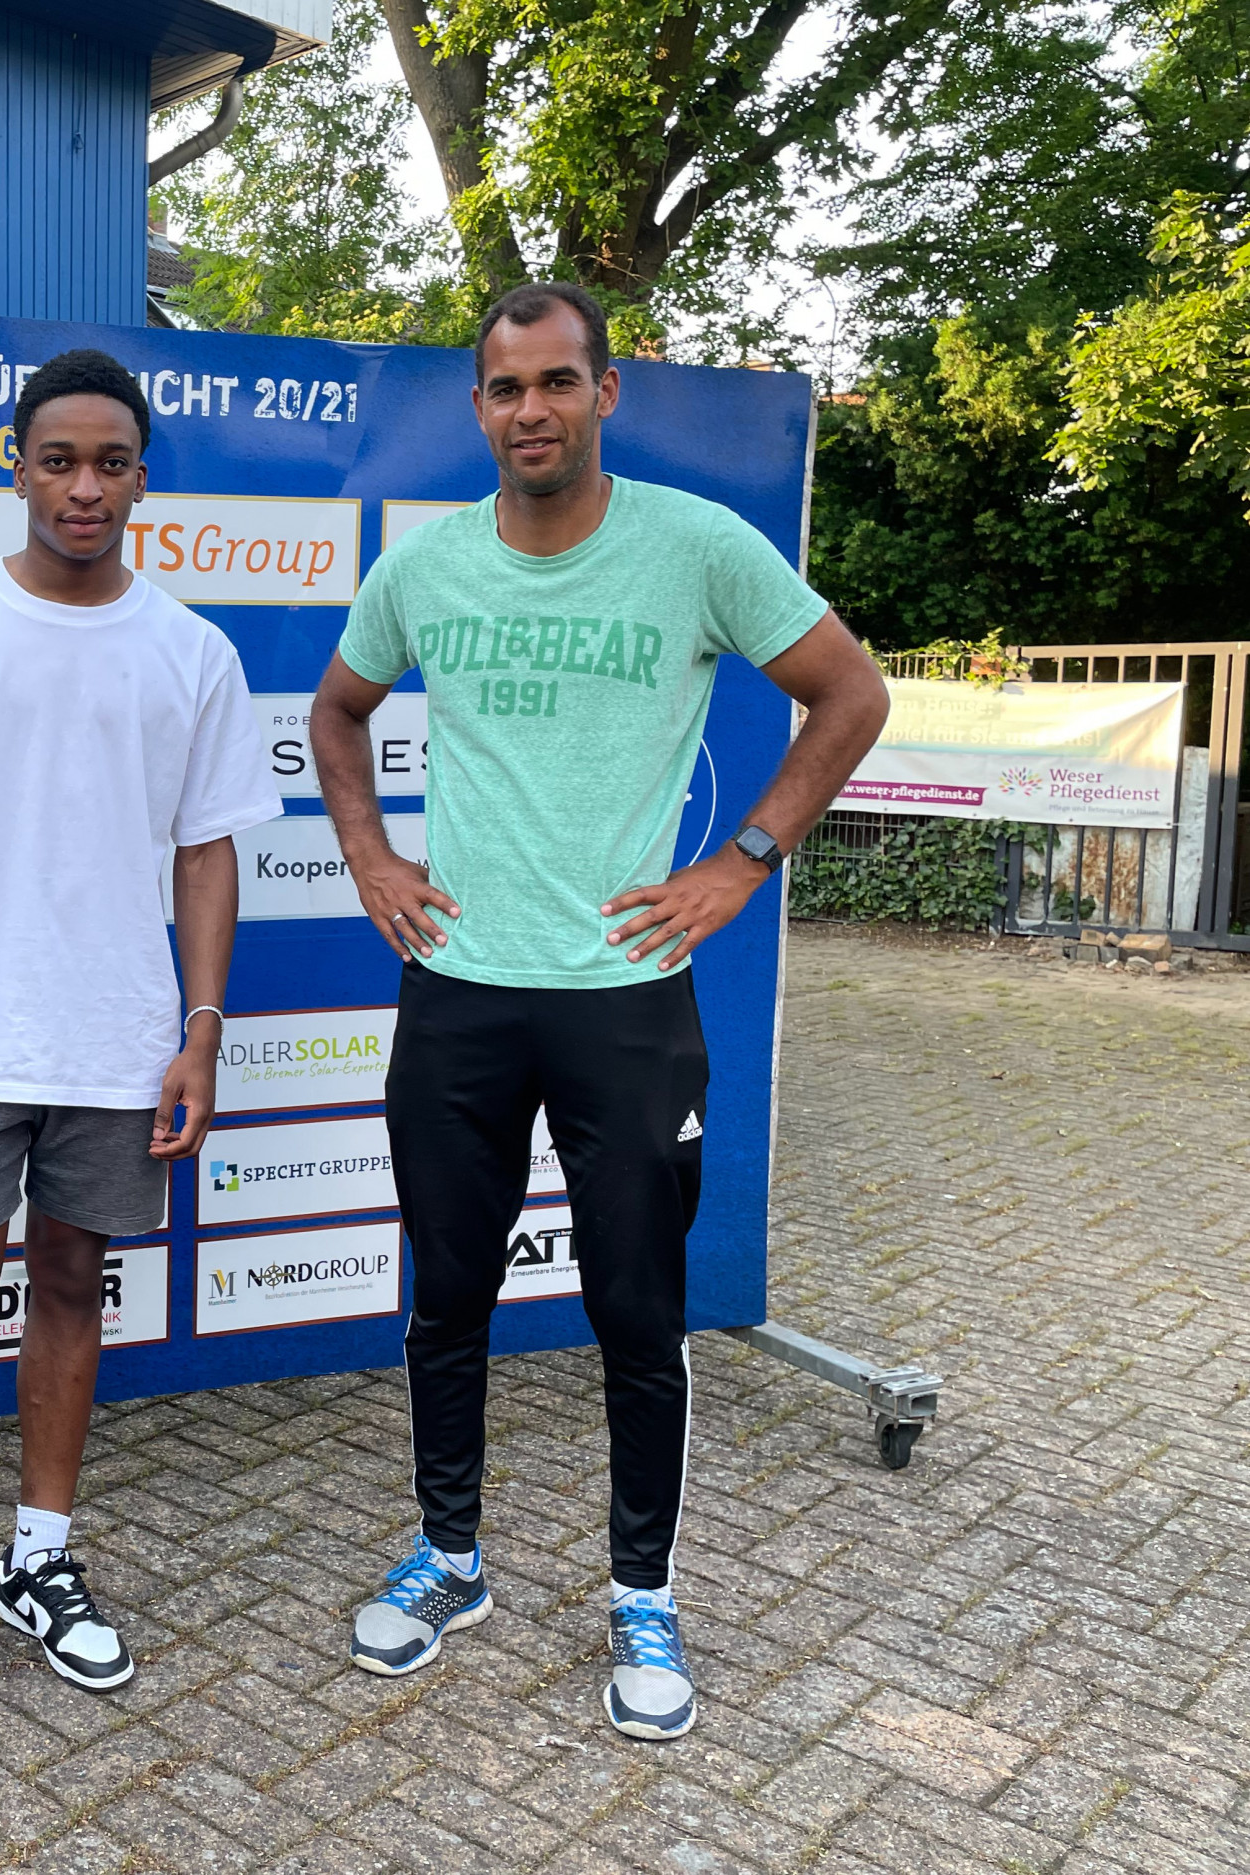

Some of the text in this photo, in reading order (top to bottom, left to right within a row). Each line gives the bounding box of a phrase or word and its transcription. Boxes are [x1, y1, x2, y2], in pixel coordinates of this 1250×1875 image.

[254, 377, 357, 423] 20/21
[126, 523, 335, 586] TSGroup
[477, 678, 559, 717] 1991
[1050, 768, 1104, 783] Weser
[843, 784, 979, 801] w.weser-pflegedienst.de
[1050, 784, 1160, 803] Pflegedienst
[257, 853, 348, 883] Kooper
[241, 1067, 260, 1083] Die
[264, 1067, 305, 1080] Bremer
[677, 1126, 702, 1142] adidas
[243, 1156, 390, 1183] SPECHT GRUPPE
